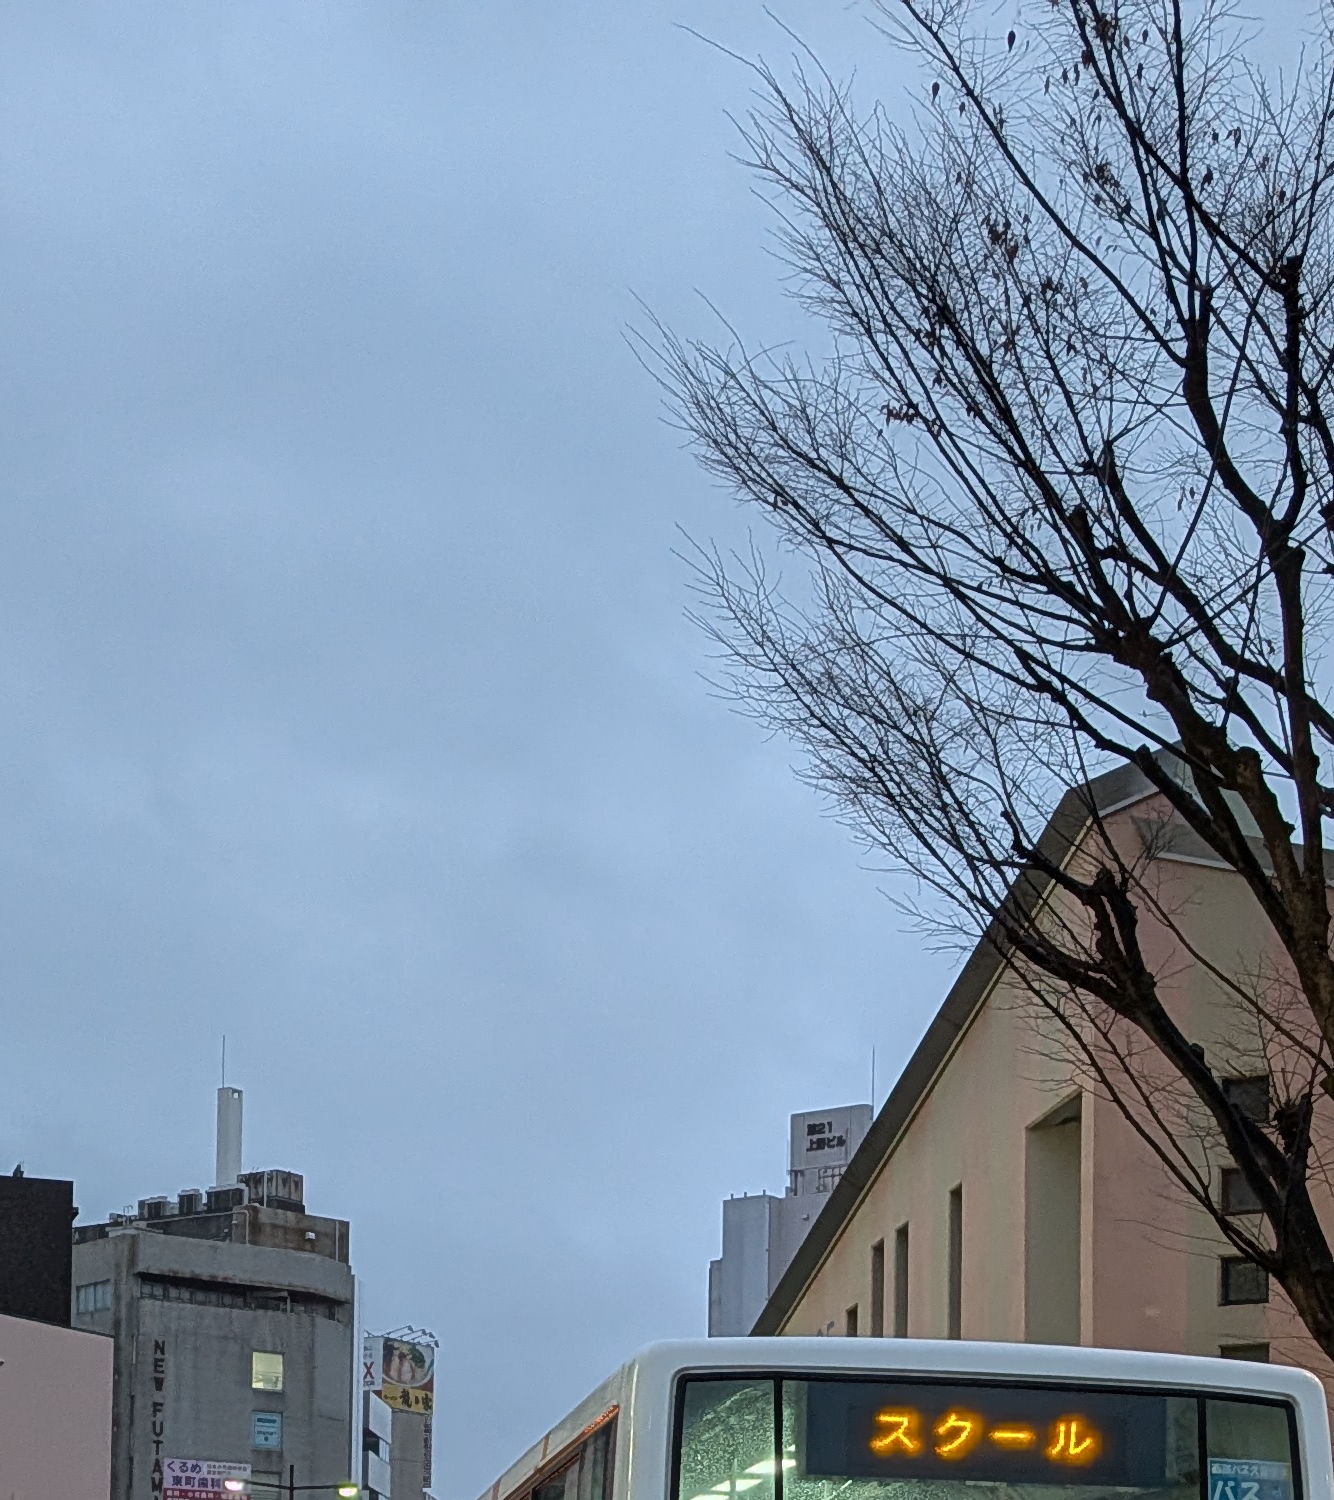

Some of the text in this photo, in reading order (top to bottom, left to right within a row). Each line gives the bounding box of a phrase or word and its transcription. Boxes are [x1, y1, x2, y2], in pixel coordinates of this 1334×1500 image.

[153, 1339, 166, 1392] NEW
[870, 1412, 1095, 1456] スクール
[167, 1460, 202, 1474] くるめ
